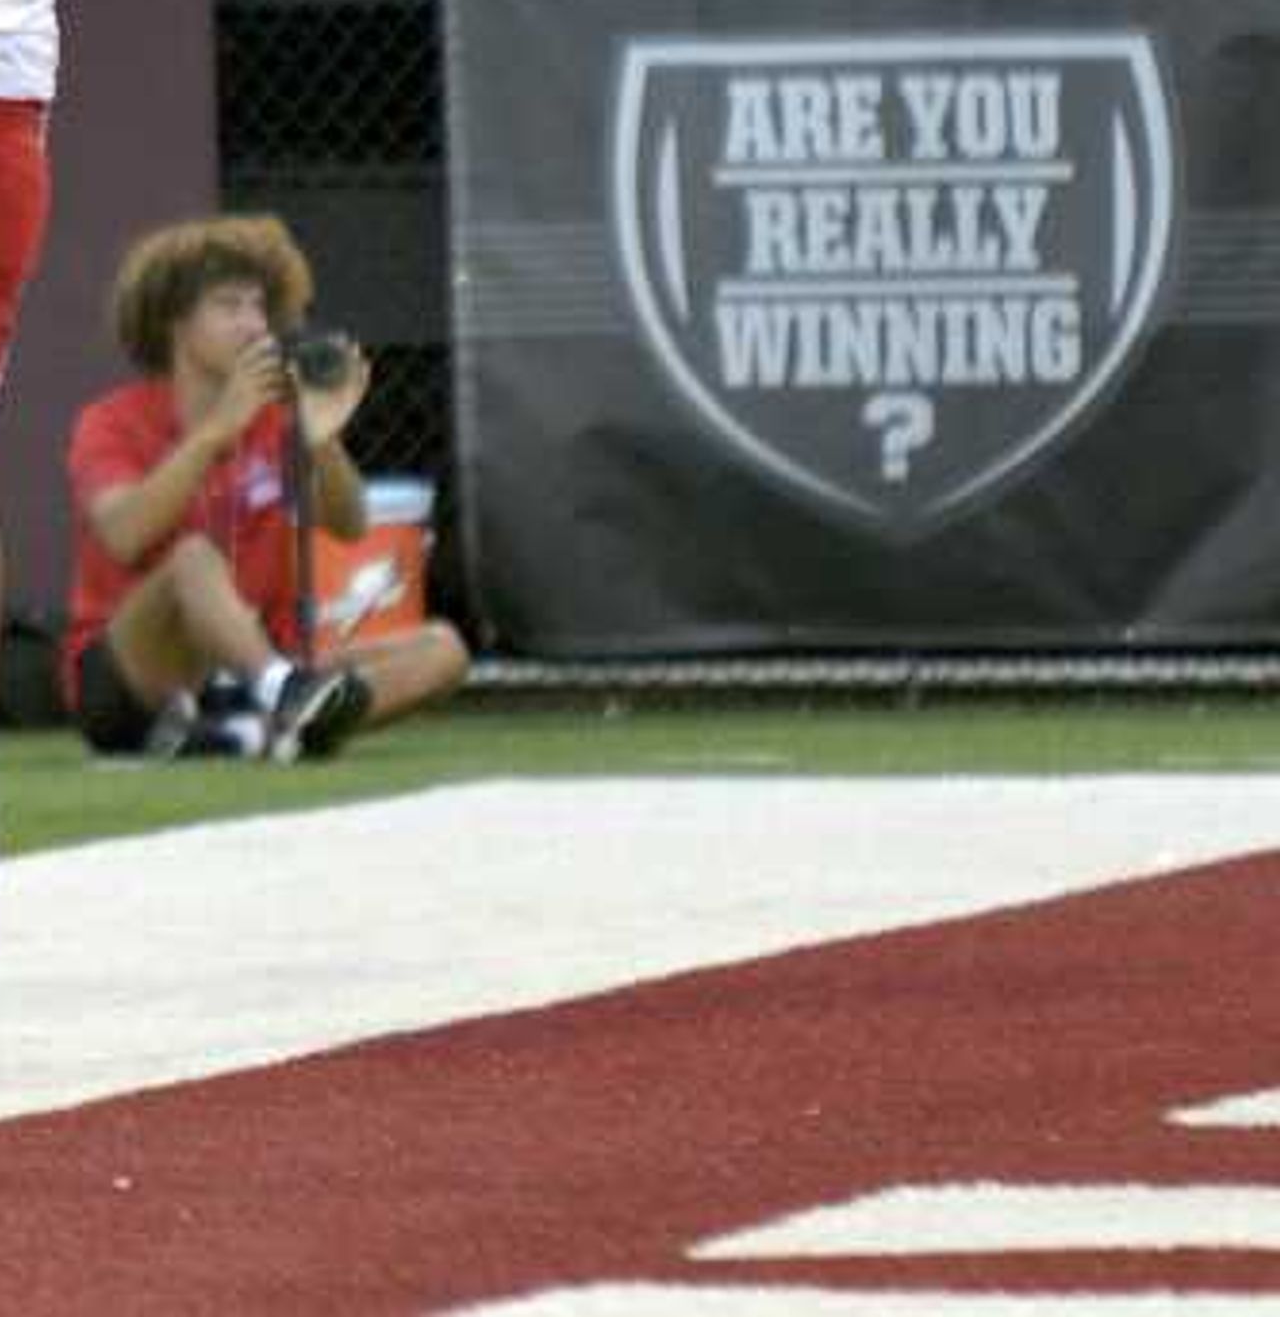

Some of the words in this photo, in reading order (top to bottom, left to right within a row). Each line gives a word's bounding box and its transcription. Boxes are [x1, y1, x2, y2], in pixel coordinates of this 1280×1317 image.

[725, 75, 884, 161] ARE
[901, 71, 1061, 160] YOU
[745, 185, 1048, 274] REALLY
[716, 294, 1081, 387] WINNING
[861, 391, 935, 481] ?
